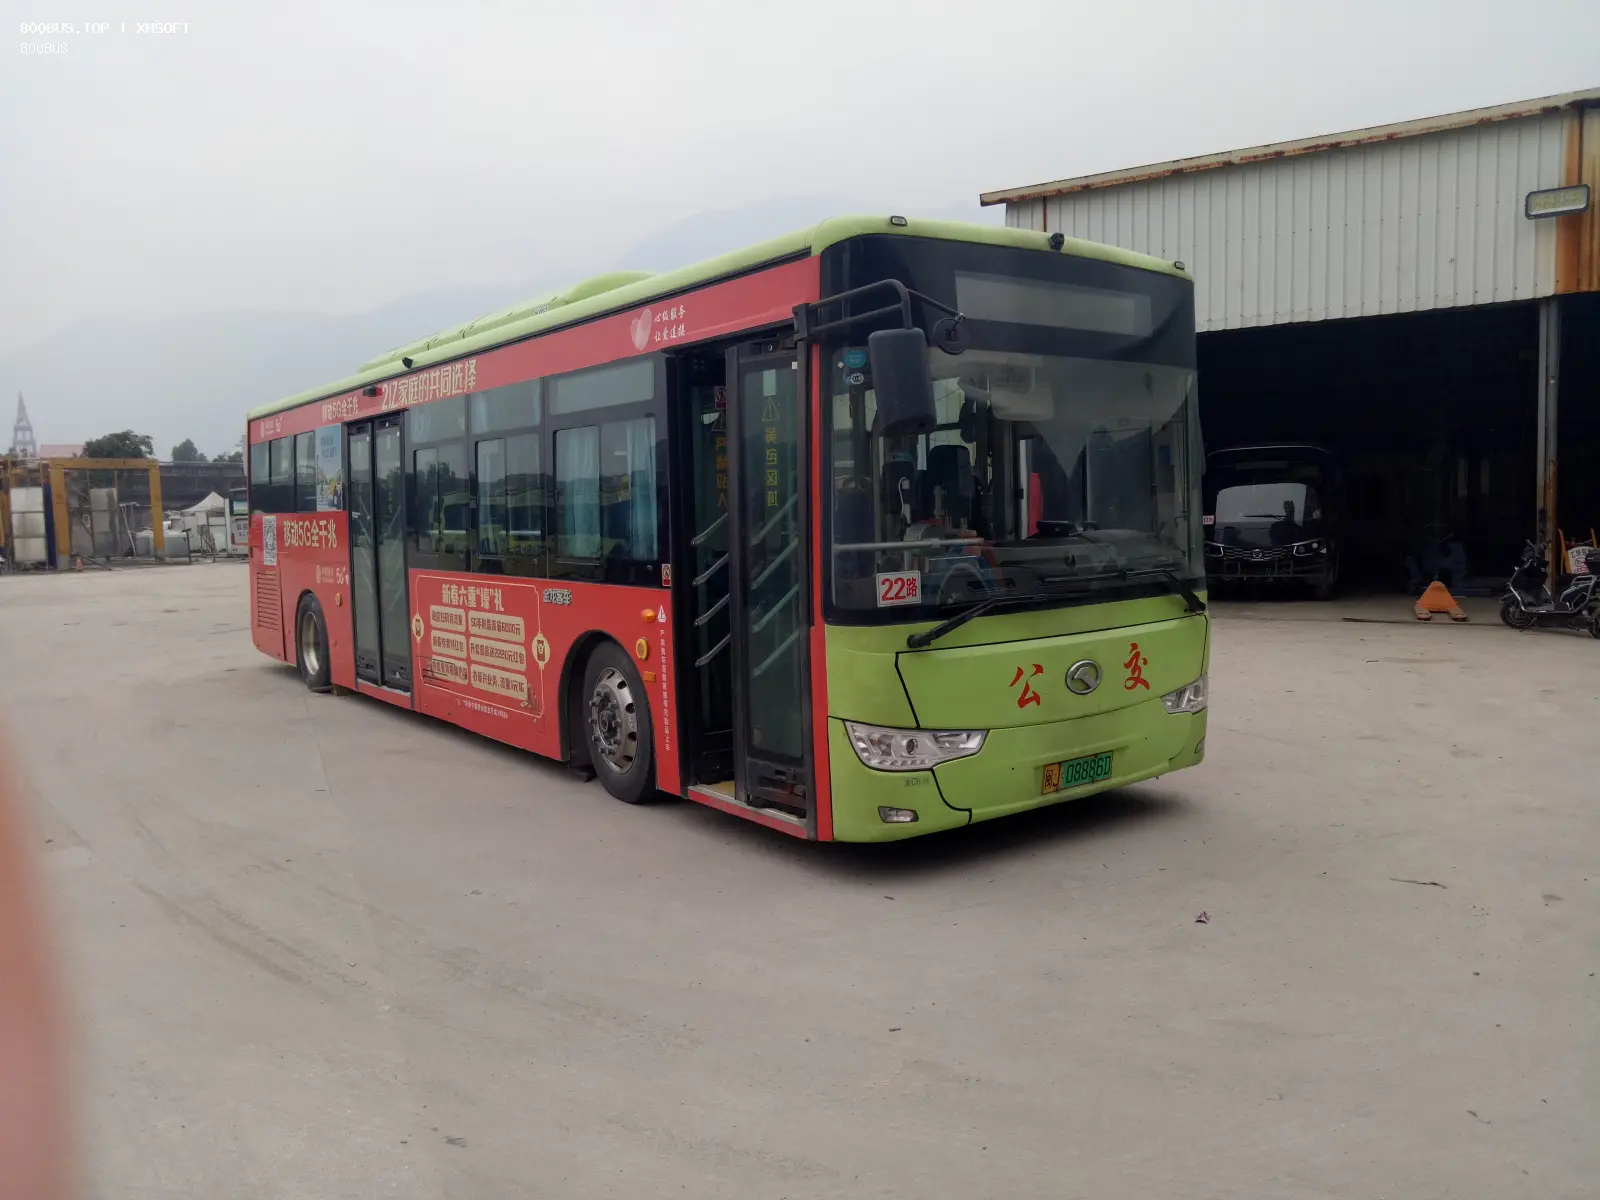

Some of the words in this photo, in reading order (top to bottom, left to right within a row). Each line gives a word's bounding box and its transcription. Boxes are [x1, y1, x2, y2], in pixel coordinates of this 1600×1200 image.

[283, 518, 338, 550] 移动5G全千兆
[881, 577, 918, 601] 22路
[1009, 663, 1044, 708] 公
[1123, 642, 1151, 691] 交
